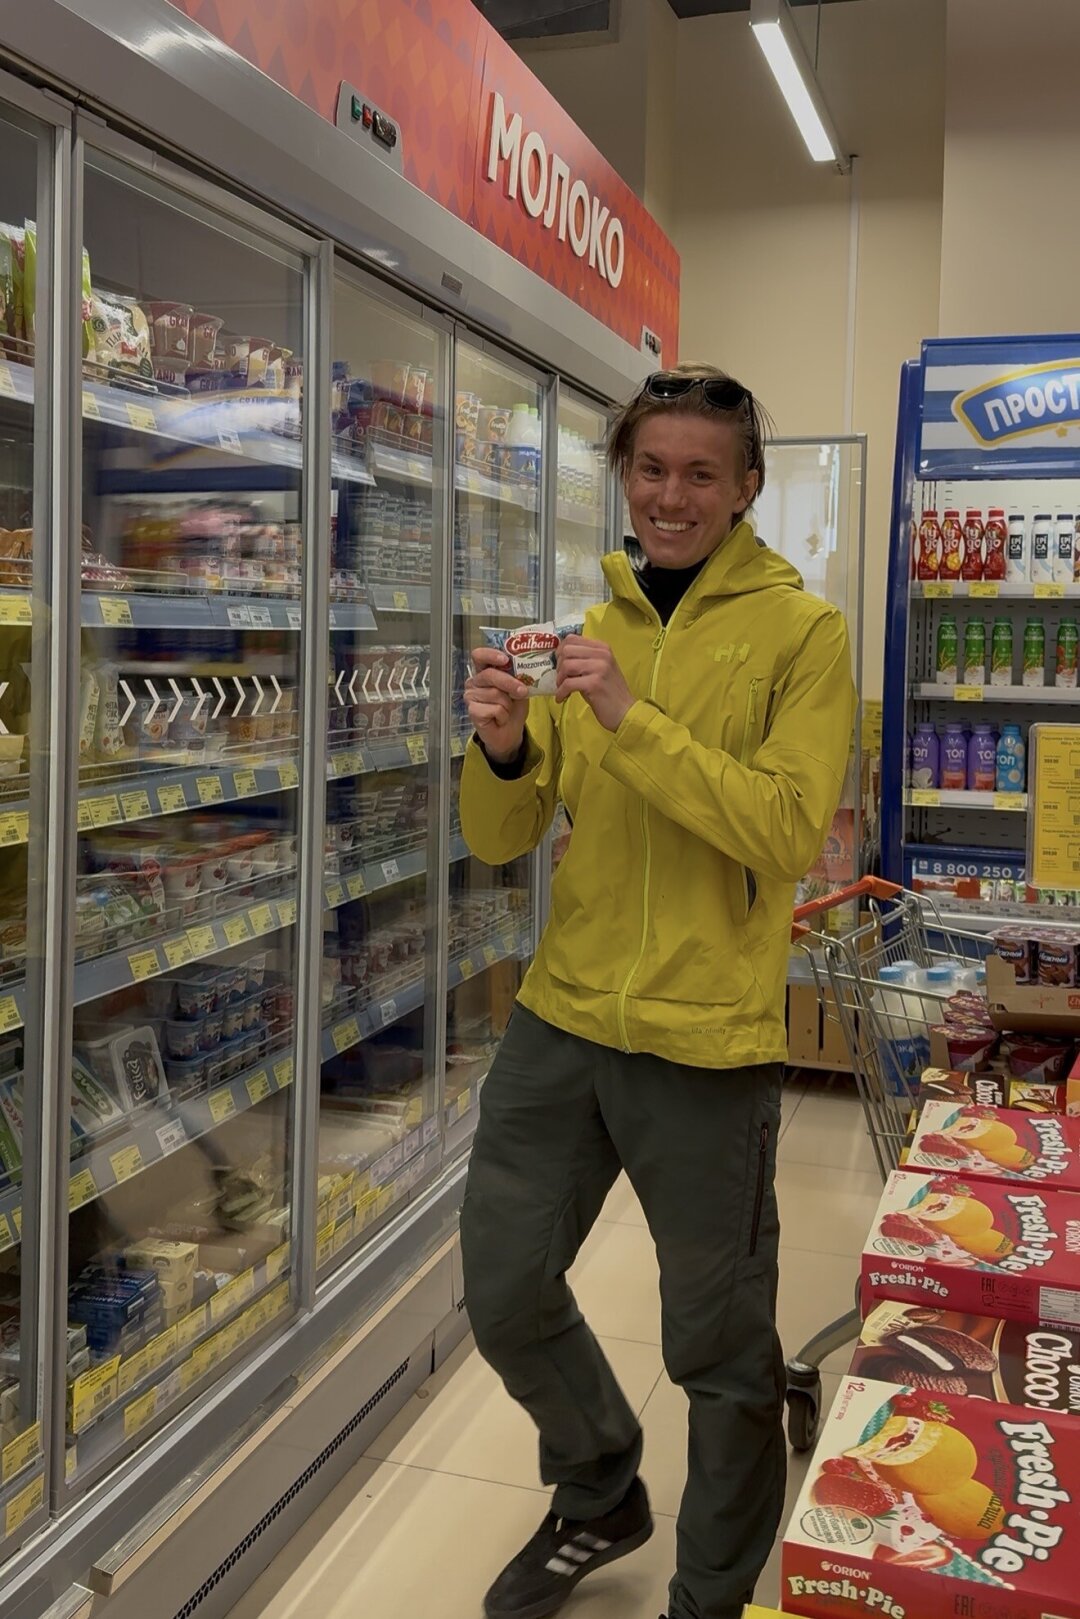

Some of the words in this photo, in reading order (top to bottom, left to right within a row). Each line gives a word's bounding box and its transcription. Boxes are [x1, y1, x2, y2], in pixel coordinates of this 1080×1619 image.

[487, 91, 625, 288] МОЛОКО
[511, 633, 555, 651] Galbani
[933, 862, 942, 874] 8
[946, 864, 977, 876] 800
[983, 866, 1012, 878] 250
[1018, 869, 1025, 879] 7
[832, 1564, 872, 1580] ORION
